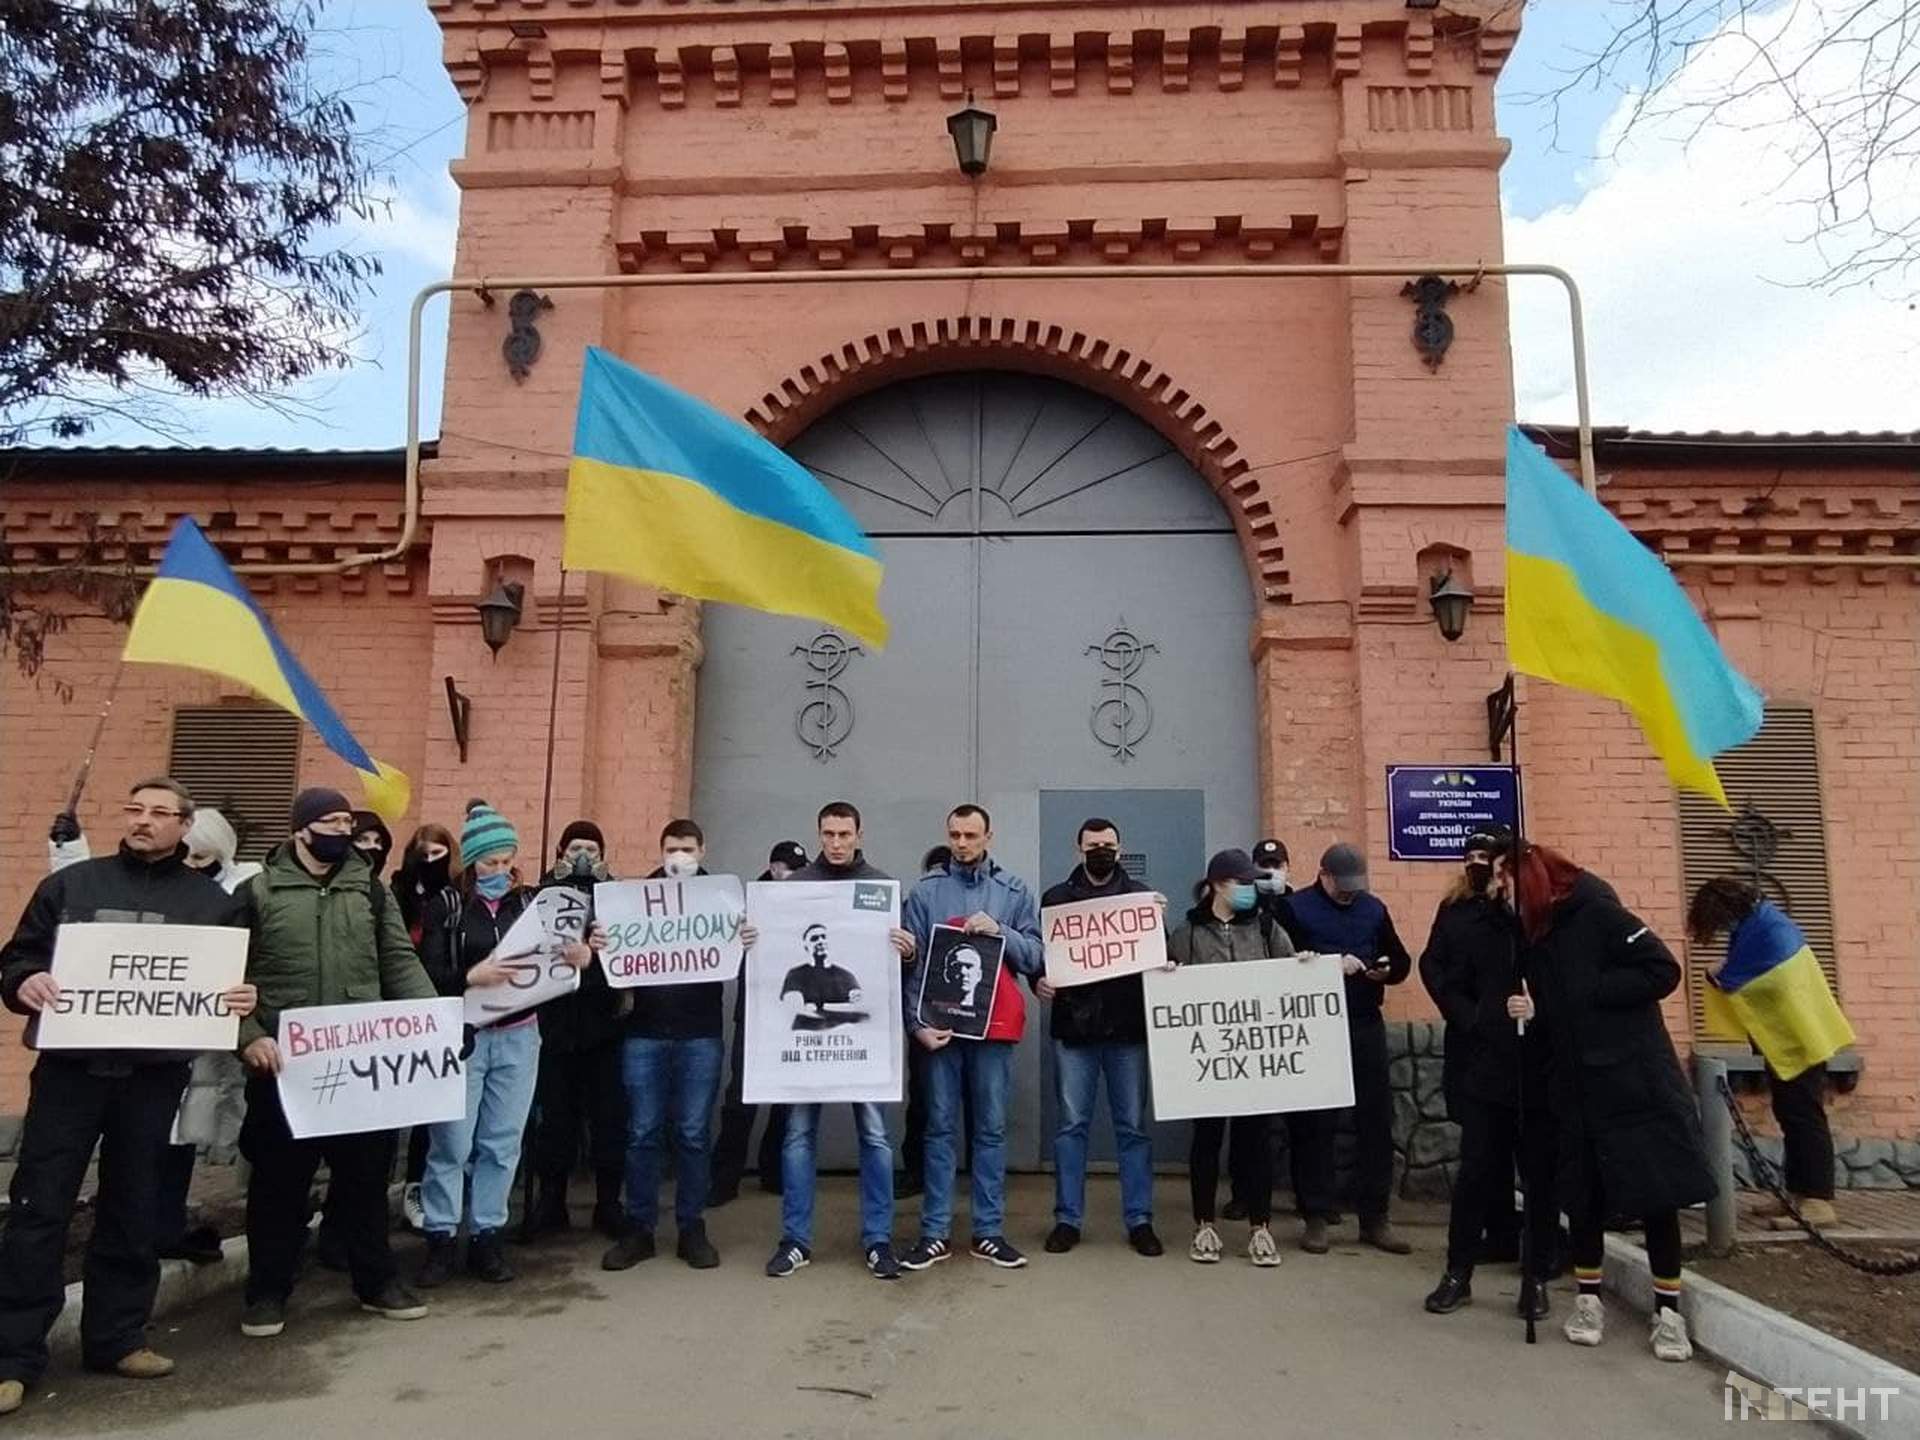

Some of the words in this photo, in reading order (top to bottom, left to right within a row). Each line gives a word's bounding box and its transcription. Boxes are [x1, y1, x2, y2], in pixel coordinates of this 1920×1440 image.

[643, 881, 684, 917] НІ
[1050, 906, 1157, 942] АВАКОВ
[109, 955, 189, 982] FREE
[609, 946, 720, 977] СВАВІЛЛЮ
[1069, 940, 1139, 970] ЧОРТ
[1152, 999, 1262, 1029] СЬОГОДНІ
[827, 1034, 853, 1047] ГЕТЬ
[1190, 1031, 1207, 1055] А
[1219, 1023, 1310, 1053] ЗАВТРА
[312, 1046, 461, 1105] #ЧУМА
[1197, 1052, 1250, 1082] УСІХ
[1260, 1051, 1306, 1078] НАС
